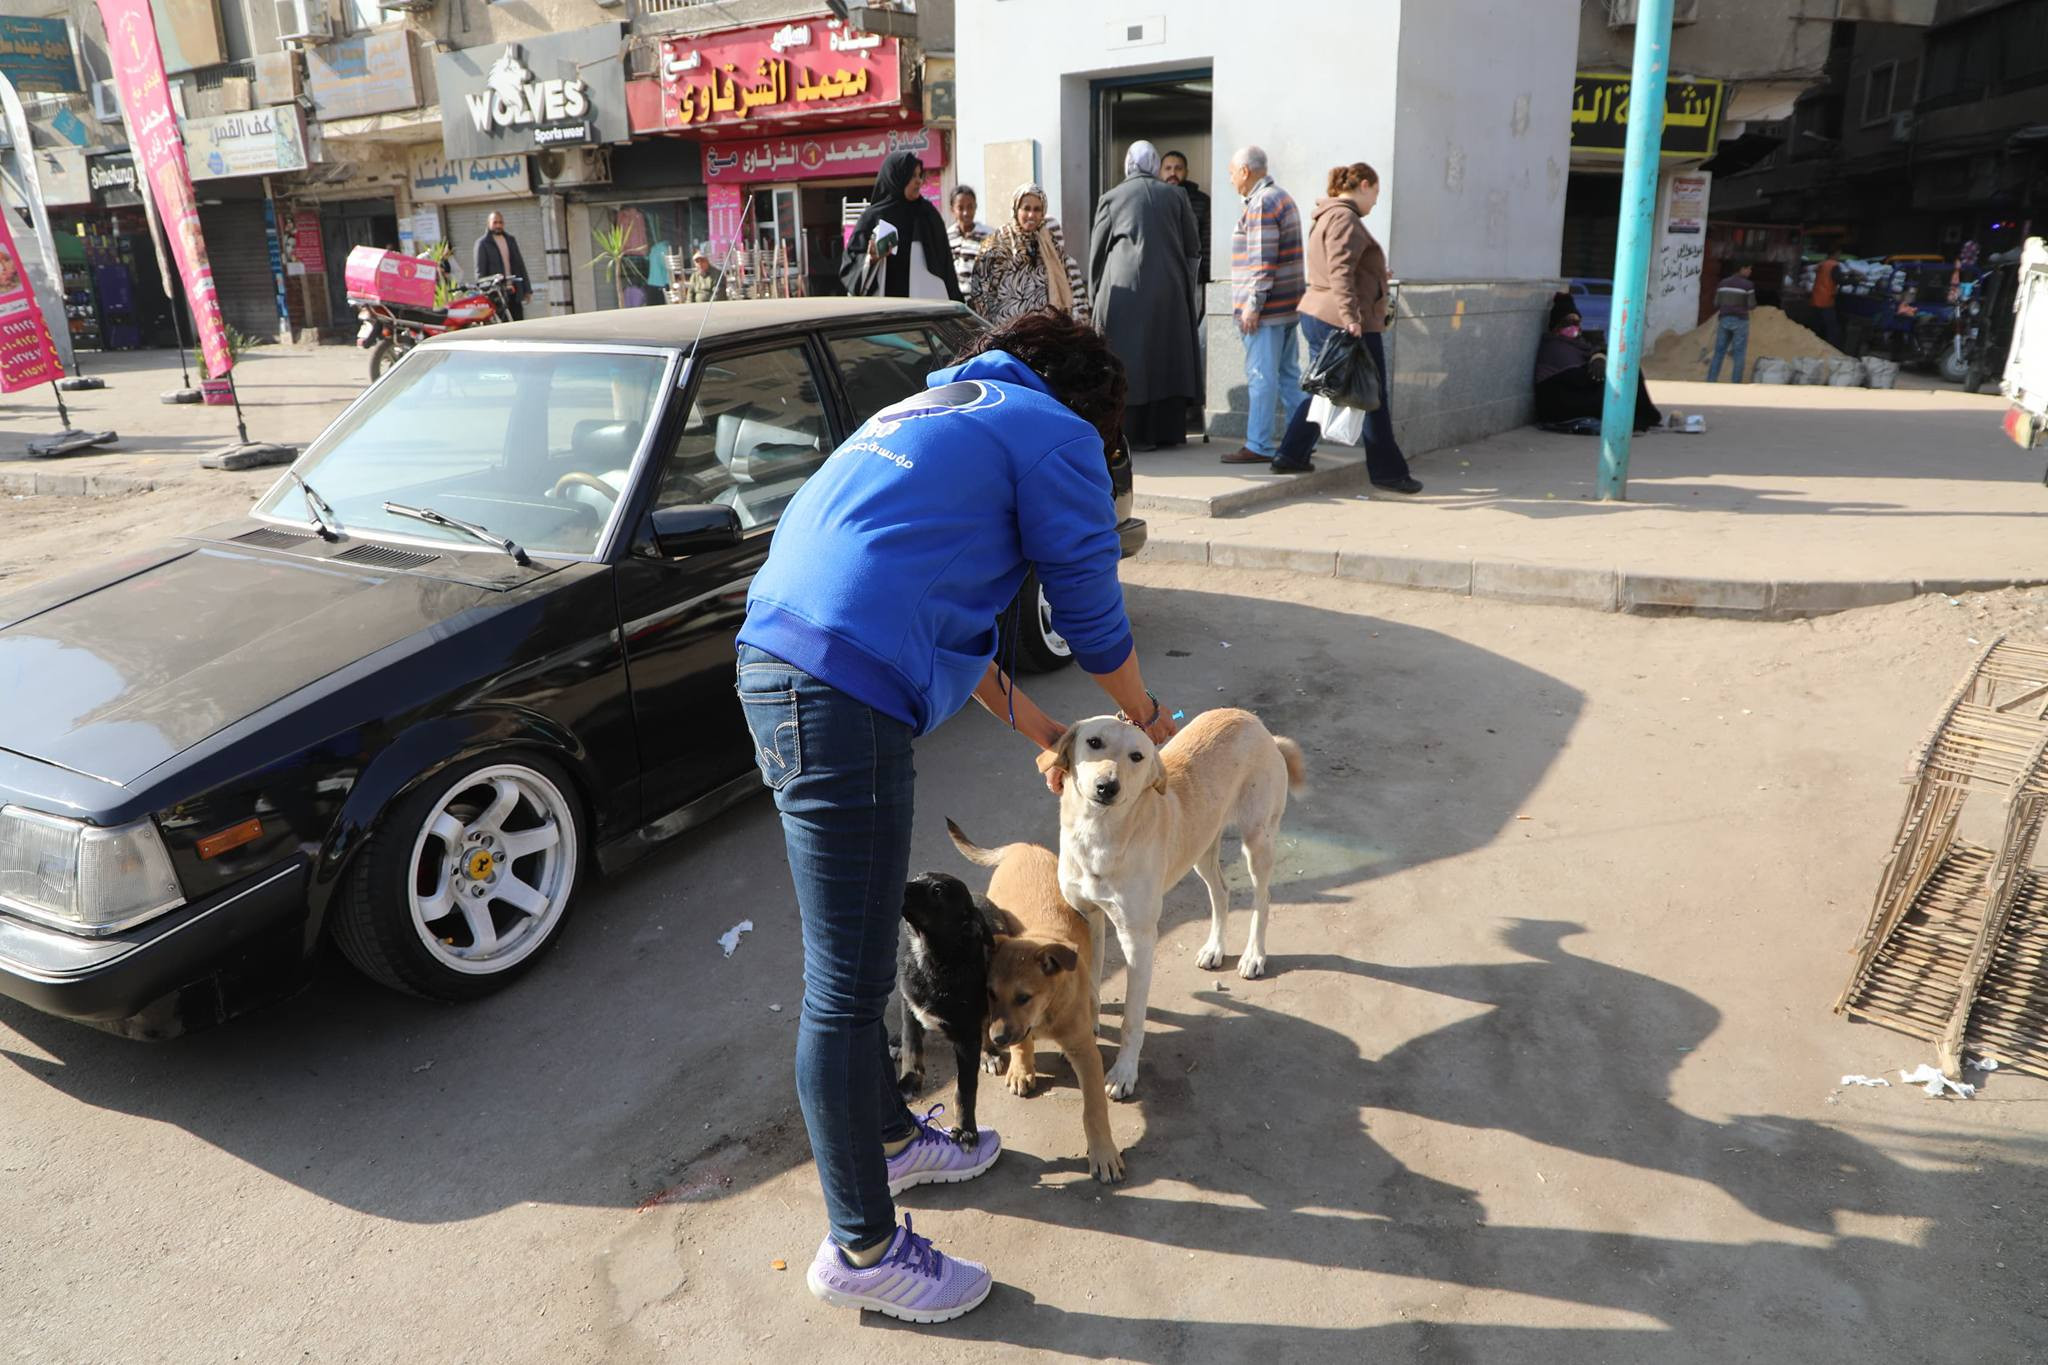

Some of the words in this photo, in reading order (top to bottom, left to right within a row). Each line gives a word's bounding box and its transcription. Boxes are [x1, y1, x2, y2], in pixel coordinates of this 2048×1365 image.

[795, 66, 868, 101] محمد
[464, 78, 589, 132] WOLVES
[1614, 84, 1711, 137] شرة
[213, 117, 246, 148] القمر
[248, 115, 272, 136] كف
[534, 127, 562, 143] Sports
[562, 125, 585, 141] wear
[707, 146, 739, 177] مخ
[825, 140, 886, 162] محمد
[867, 441, 914, 469] مؤسسة
